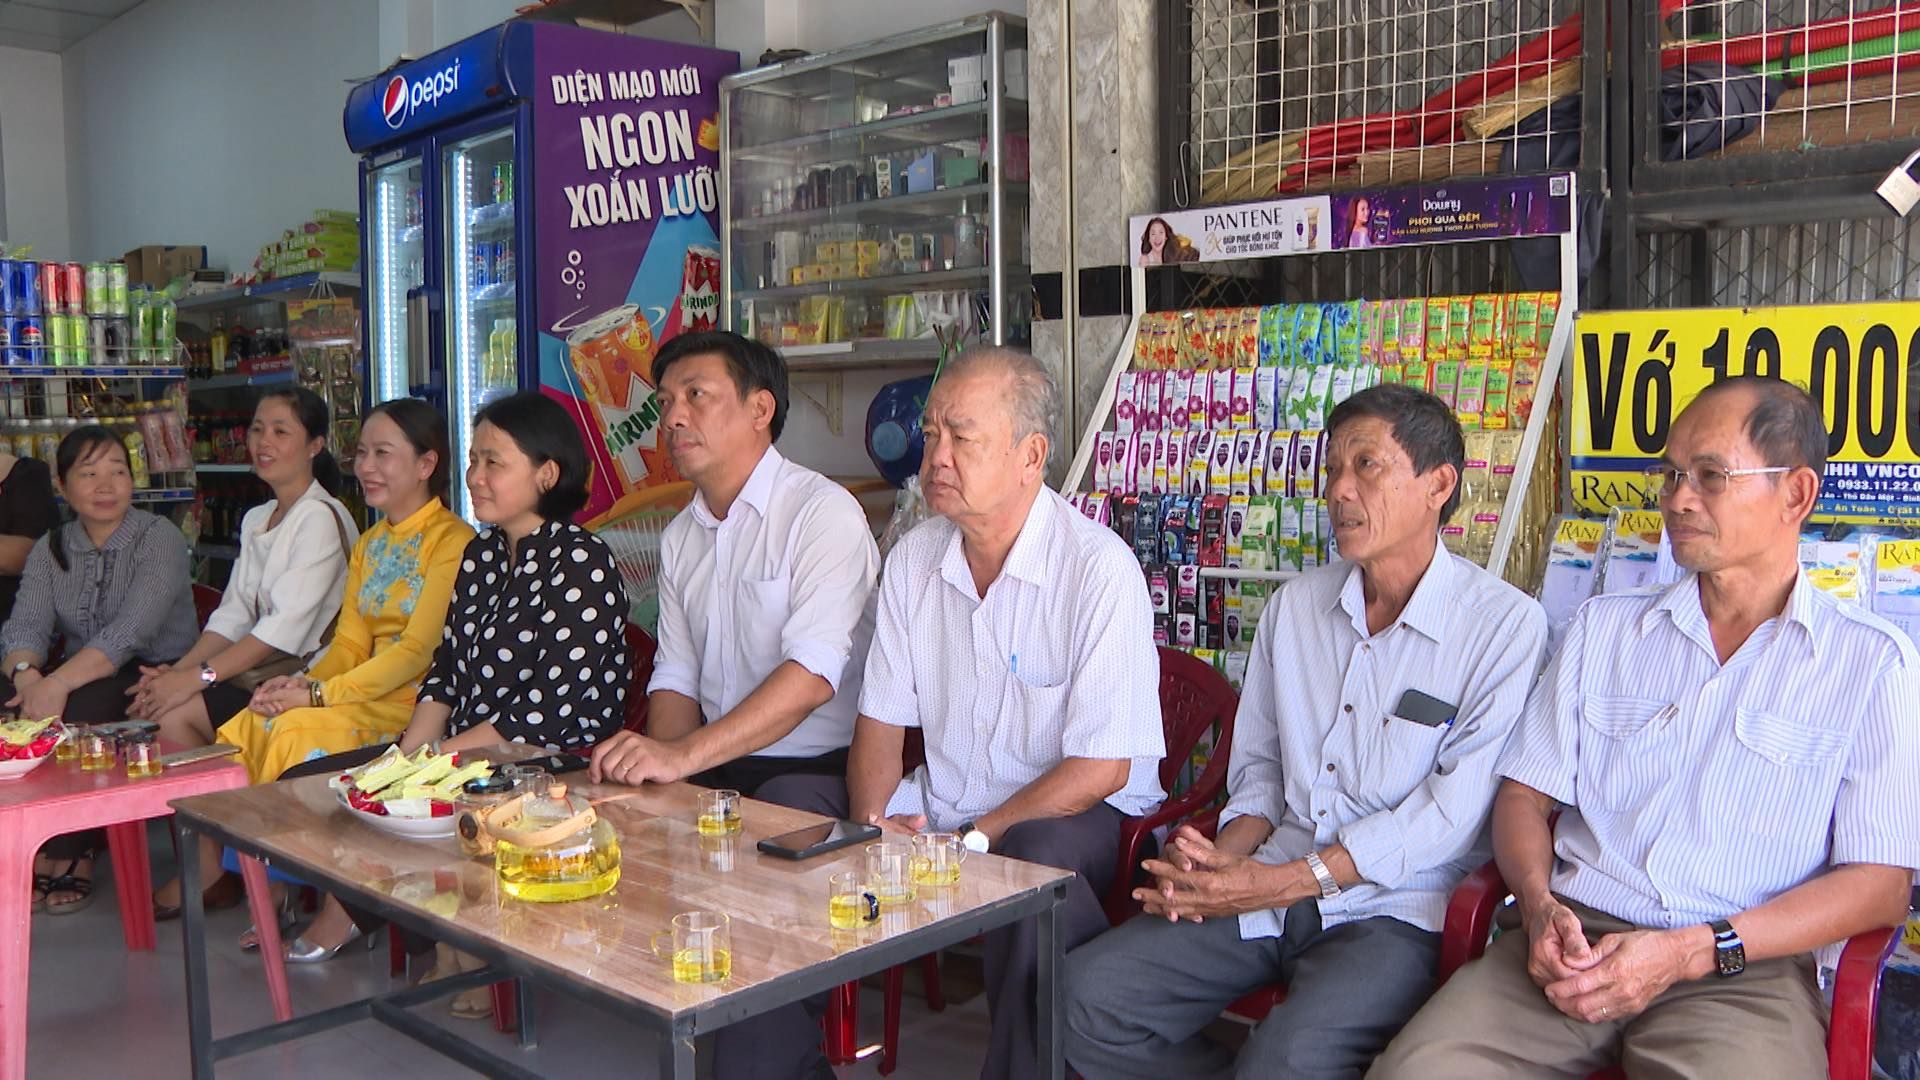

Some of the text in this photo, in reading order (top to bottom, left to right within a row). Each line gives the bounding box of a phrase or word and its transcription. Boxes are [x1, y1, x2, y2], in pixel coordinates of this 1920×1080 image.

[411, 57, 460, 117] pepsi
[551, 64, 701, 107] DIỆN MẠO MỚI
[580, 109, 695, 170] NGON
[564, 169, 651, 229] XOẮN
[1422, 199, 1461, 212] Downy
[1203, 207, 1284, 232] PANTENE
[1434, 215, 1456, 225] QUA
[1581, 329, 1676, 454] Vớ
[1560, 521, 1600, 540] RANI
[1621, 511, 1662, 532] RANI
